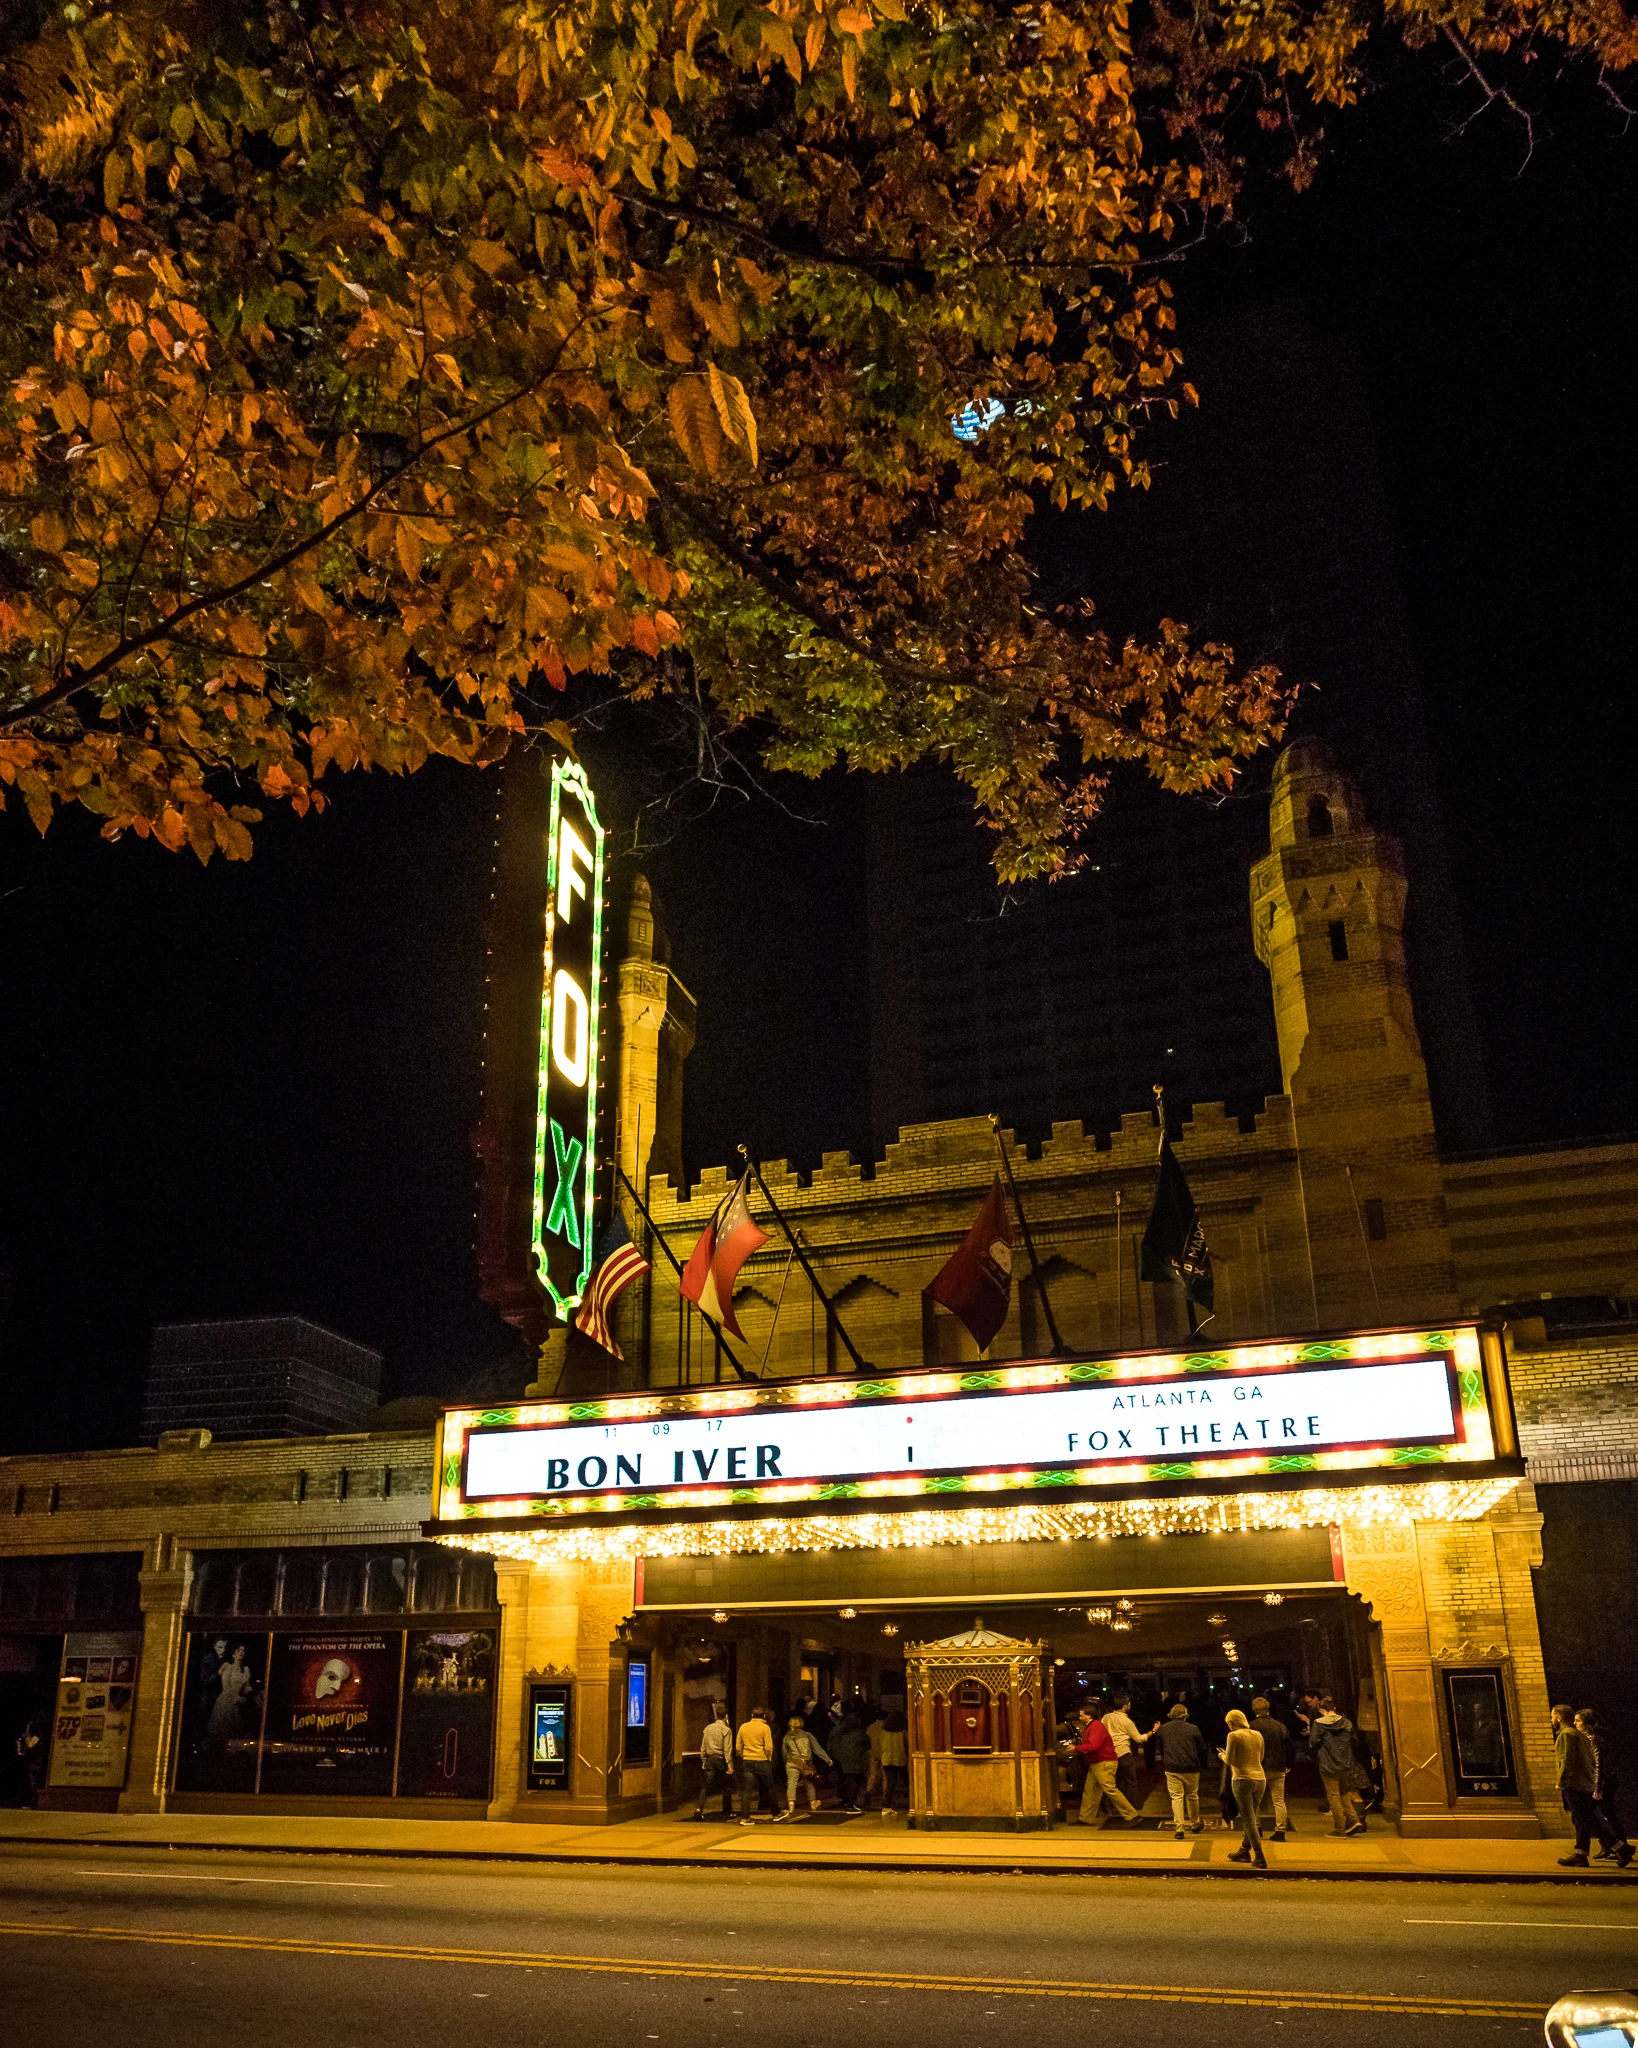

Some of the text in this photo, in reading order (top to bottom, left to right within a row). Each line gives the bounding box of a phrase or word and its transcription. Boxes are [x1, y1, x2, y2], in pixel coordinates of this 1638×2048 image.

[546, 816, 594, 1250] FOX
[1112, 1386, 1264, 1411] ATLANTA GA
[605, 1419, 723, 1438] 11 09 17
[1067, 1415, 1322, 1453] FOX THEATRE
[546, 1444, 783, 1490] BON IVER
[363, 1642, 386, 1650] OPERA
[292, 1710, 368, 1733] Love Never Dies
[1473, 1782, 1498, 1791] FOX
